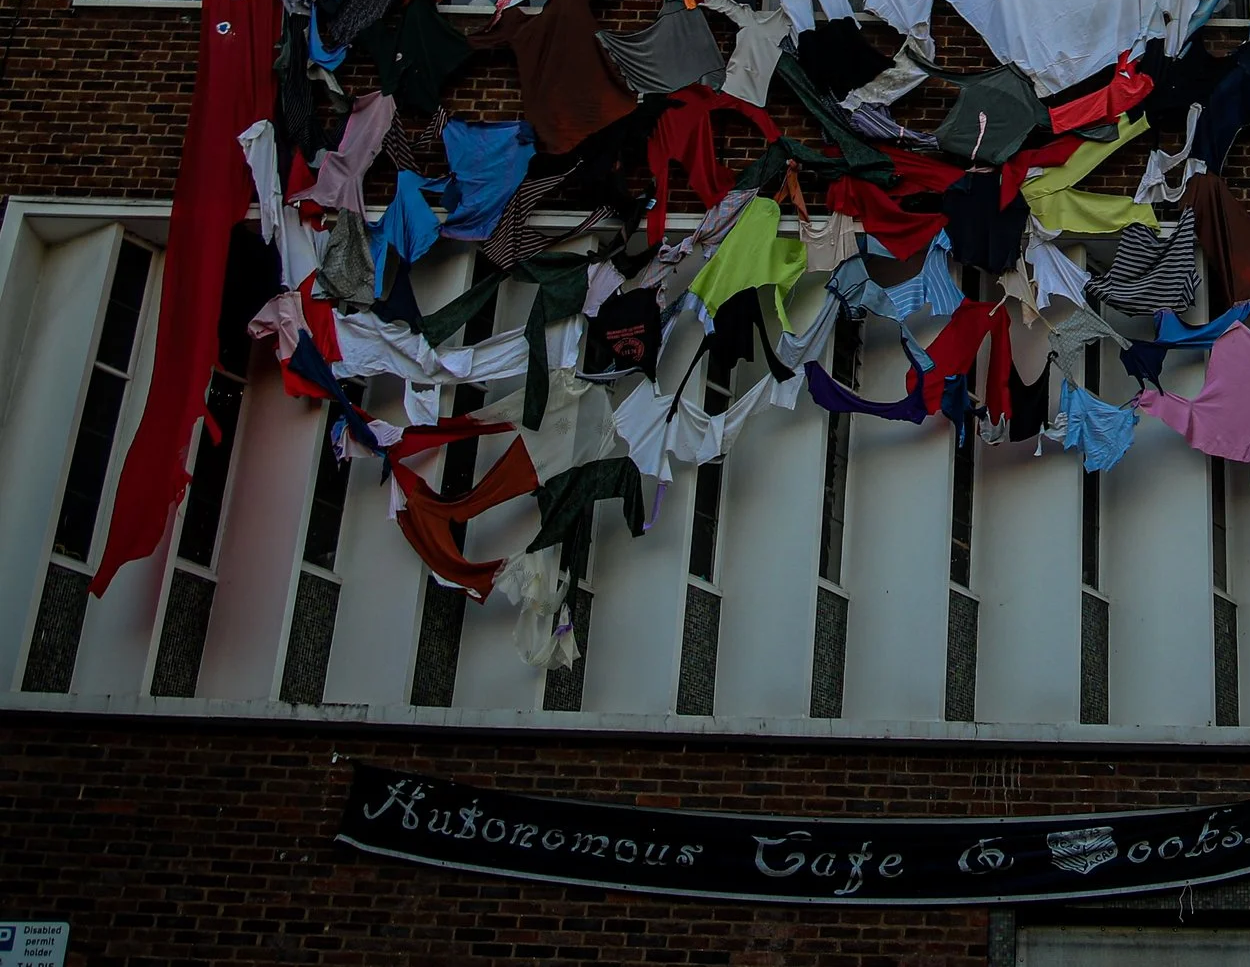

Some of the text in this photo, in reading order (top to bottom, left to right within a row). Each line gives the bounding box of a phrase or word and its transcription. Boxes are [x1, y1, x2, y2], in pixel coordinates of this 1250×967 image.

[363, 778, 704, 867] Autonomous
[752, 830, 904, 896] Cafe
[24, 926, 62, 934] Disabled
[25, 937, 55, 946] permit
[24, 949, 52, 957] holder
